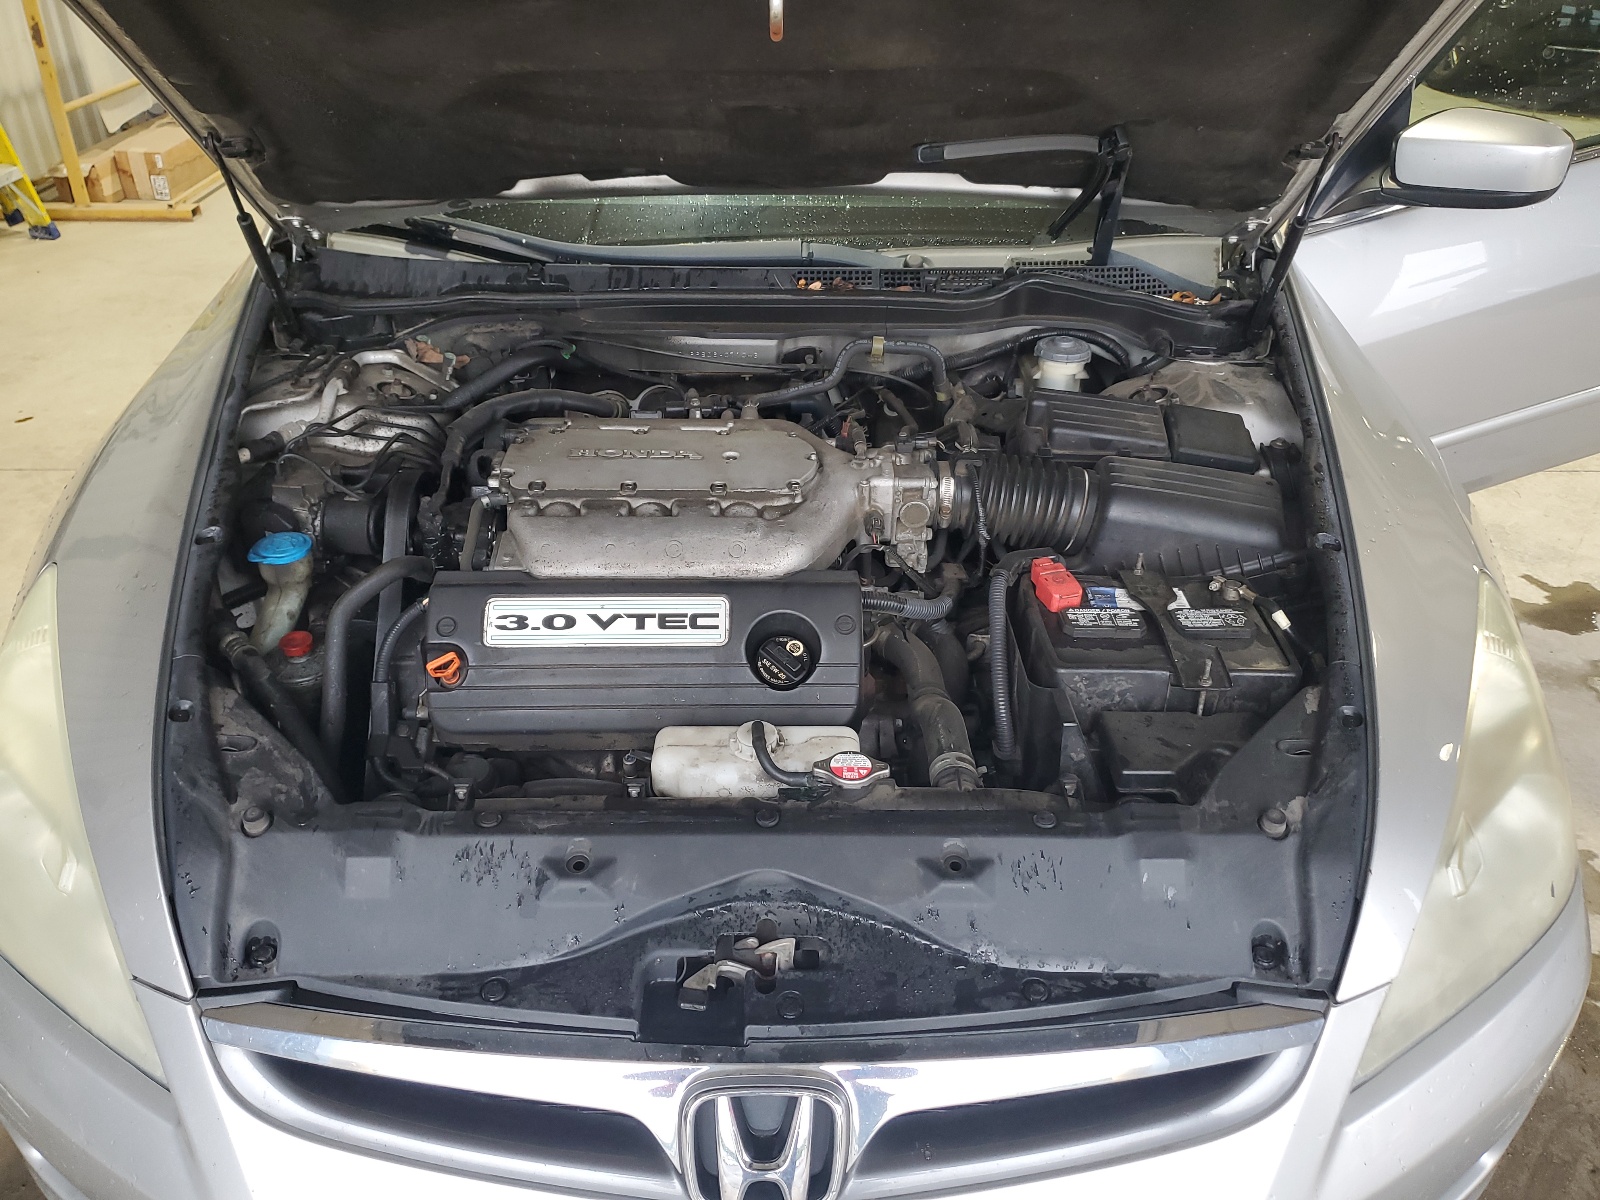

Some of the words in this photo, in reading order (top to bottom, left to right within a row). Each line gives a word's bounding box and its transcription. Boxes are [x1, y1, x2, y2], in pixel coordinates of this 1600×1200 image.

[567, 448, 704, 460] HONDA
[494, 613, 577, 631] 3.0
[586, 612, 720, 631] VTEC
